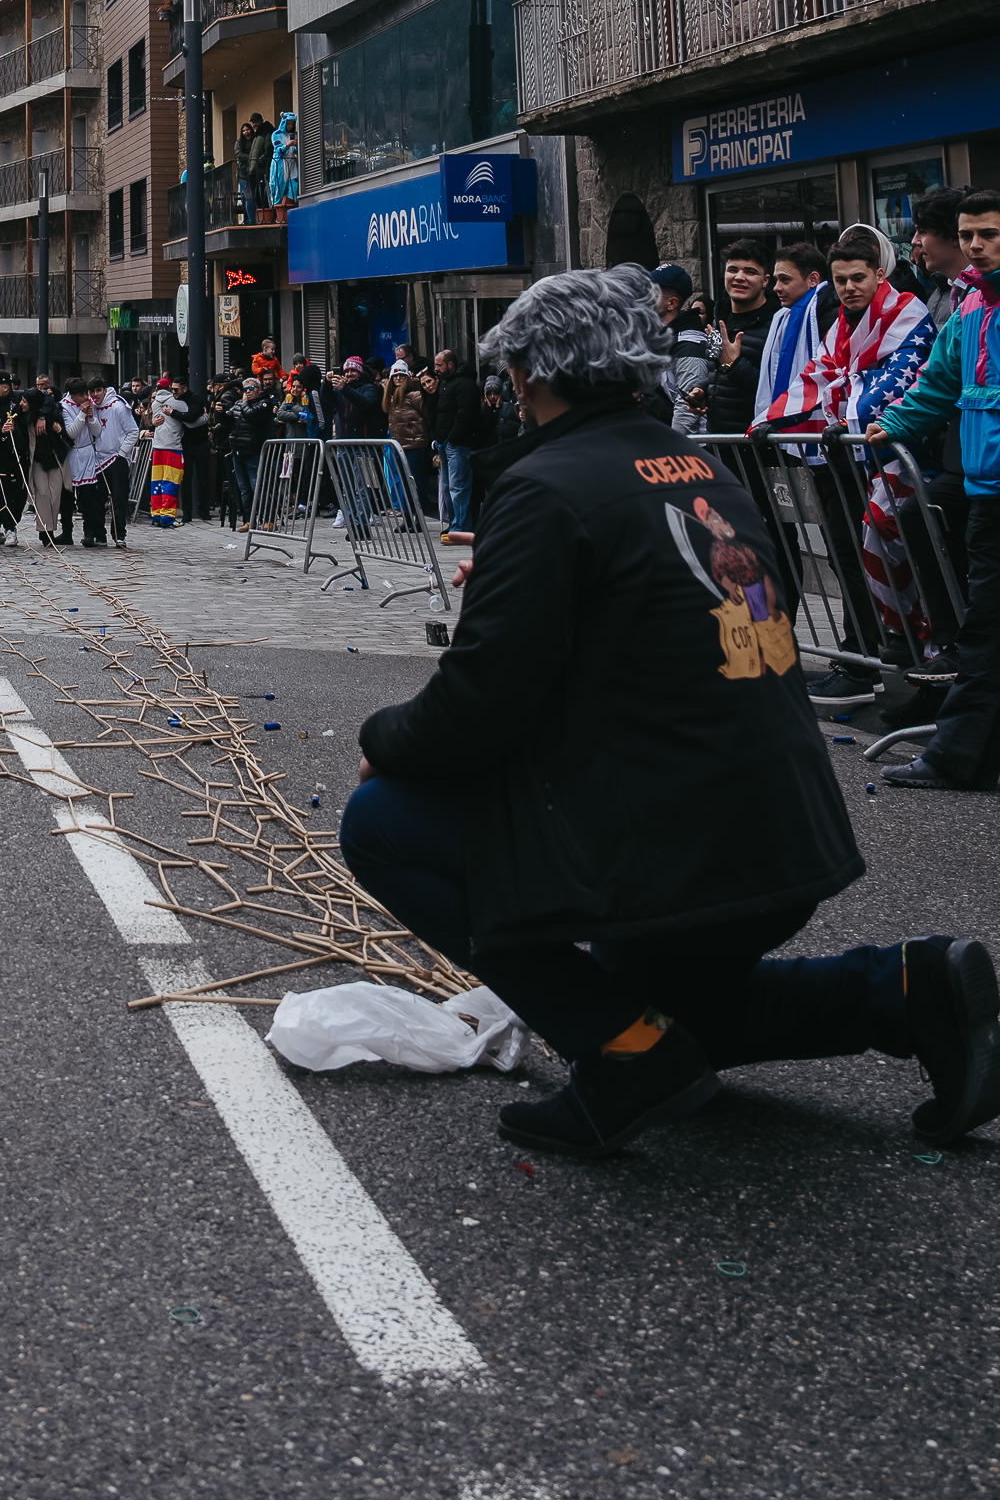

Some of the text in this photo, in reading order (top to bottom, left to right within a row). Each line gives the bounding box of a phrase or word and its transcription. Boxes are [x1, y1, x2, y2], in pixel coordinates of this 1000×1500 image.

[709, 93, 806, 140] FERRETERIA
[710, 130, 793, 172] PRINCIPAT
[453, 194, 507, 204] MORABANC
[482, 204, 500, 214] 24h
[635, 456, 714, 483] COELHO
